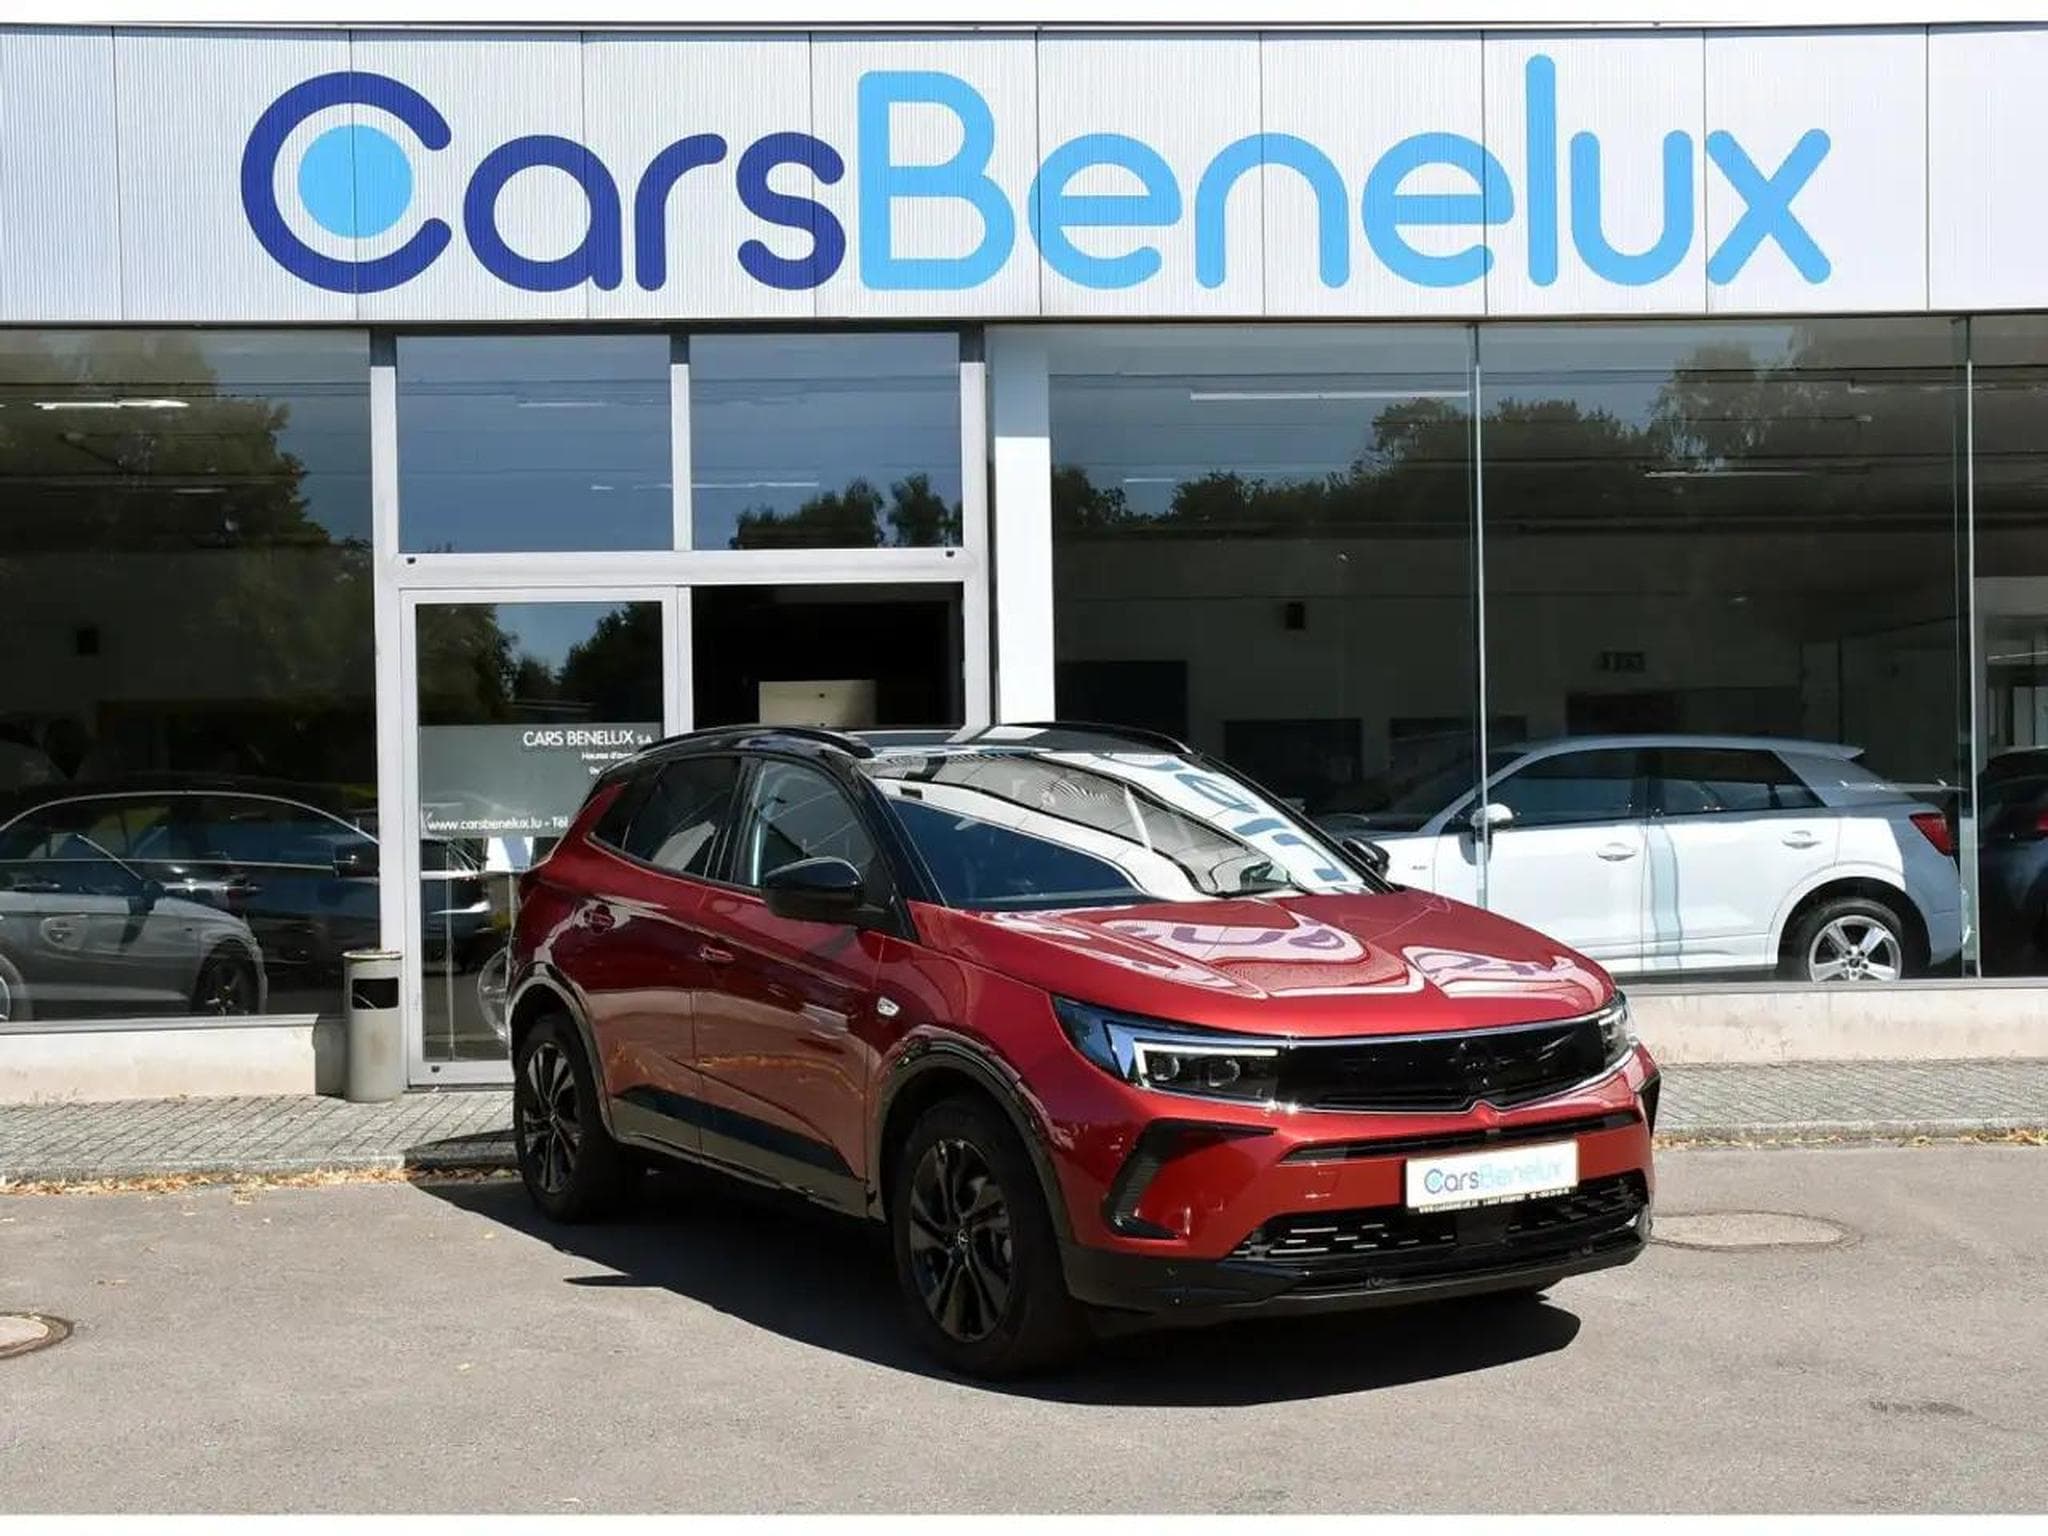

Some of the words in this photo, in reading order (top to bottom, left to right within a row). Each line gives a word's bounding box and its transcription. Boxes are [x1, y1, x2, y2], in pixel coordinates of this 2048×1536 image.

[240, 54, 1832, 293] CarsBenelux
[523, 730, 564, 747] CARS
[566, 730, 634, 746] BENELUX
